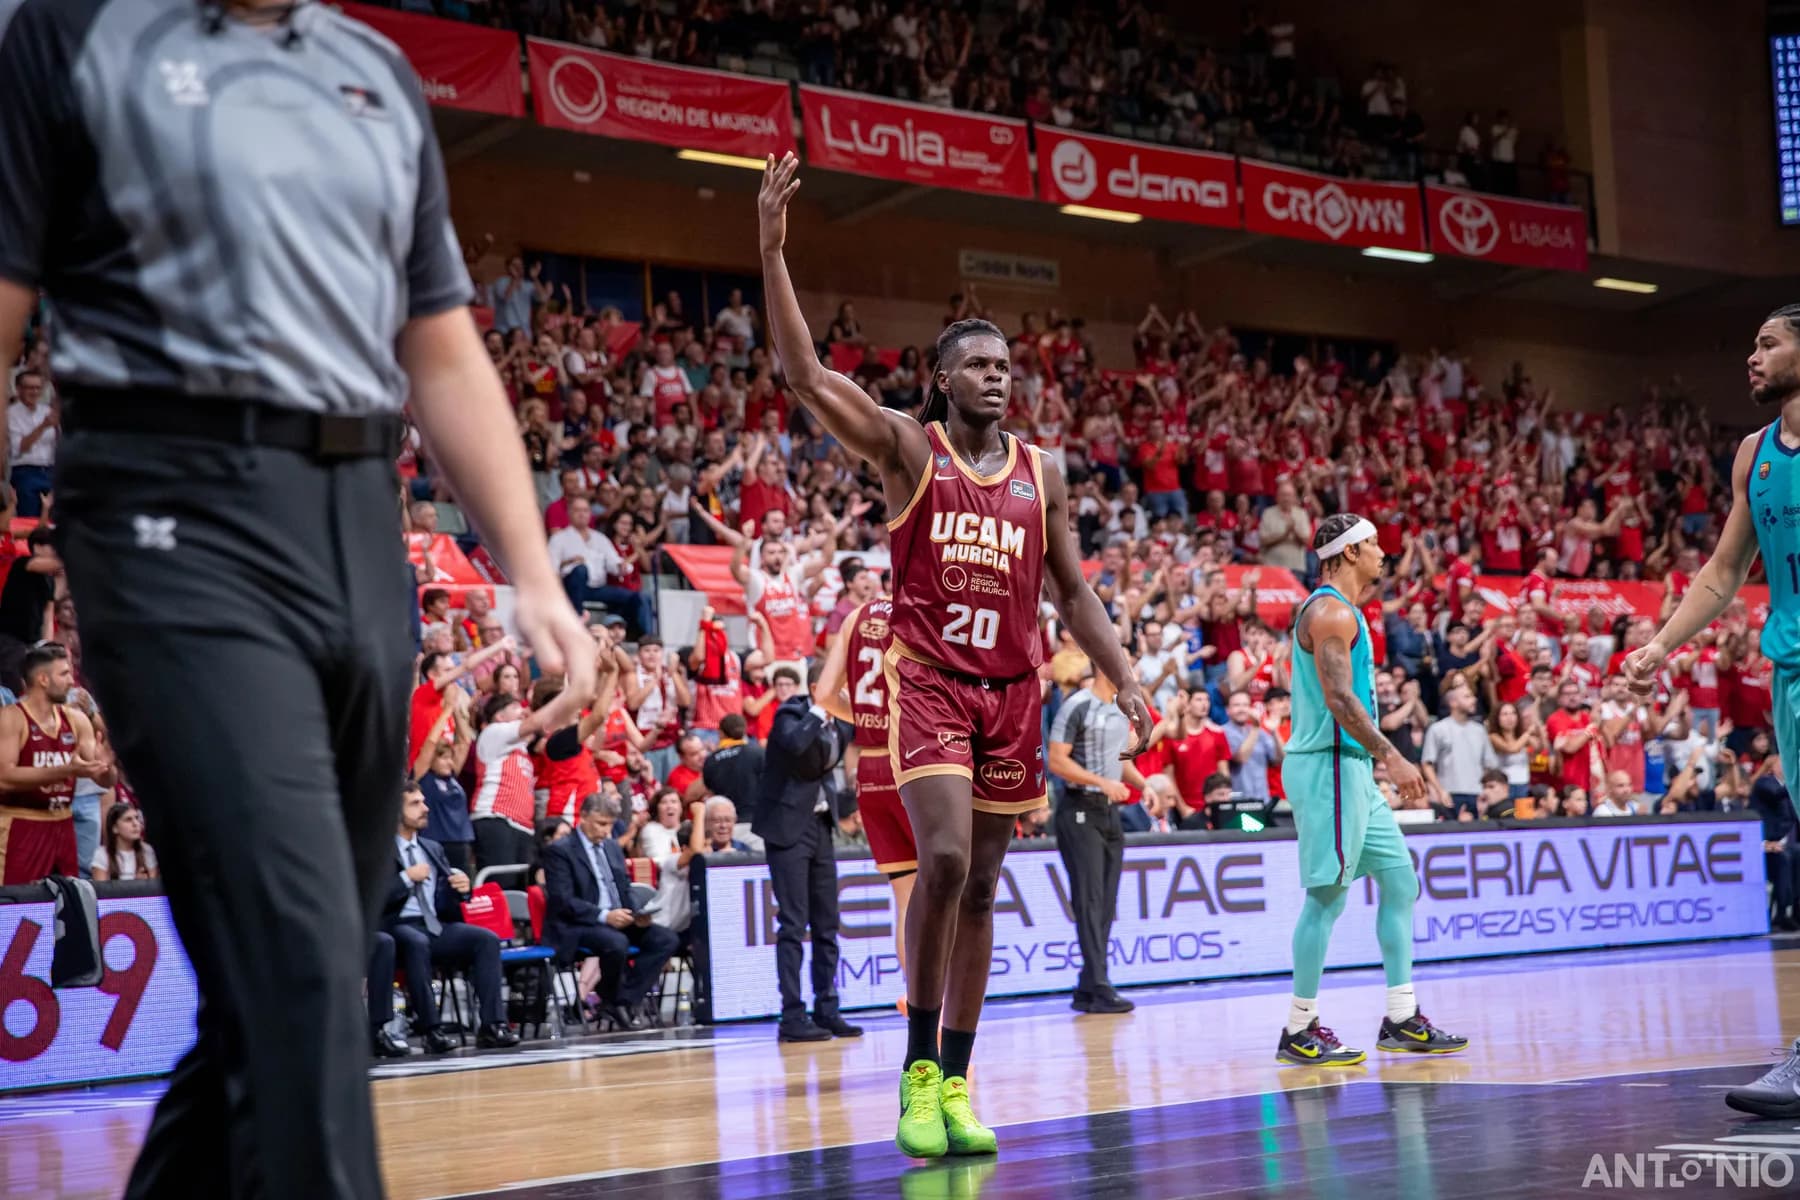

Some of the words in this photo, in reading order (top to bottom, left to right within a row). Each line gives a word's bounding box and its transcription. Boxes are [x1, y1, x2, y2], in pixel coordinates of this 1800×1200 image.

[686, 109, 710, 129] DE
[712, 112, 780, 137] MURCIA
[929, 511, 1026, 561] UCAM
[941, 543, 1011, 574] MURCIA
[1786, 552, 1800, 595] 1
[970, 584, 981, 592] DE
[981, 586, 1010, 597] MURCIA
[941, 602, 1001, 650] 20
[985, 767, 1024, 781] Juver
[1578, 832, 1743, 890] VITAE
